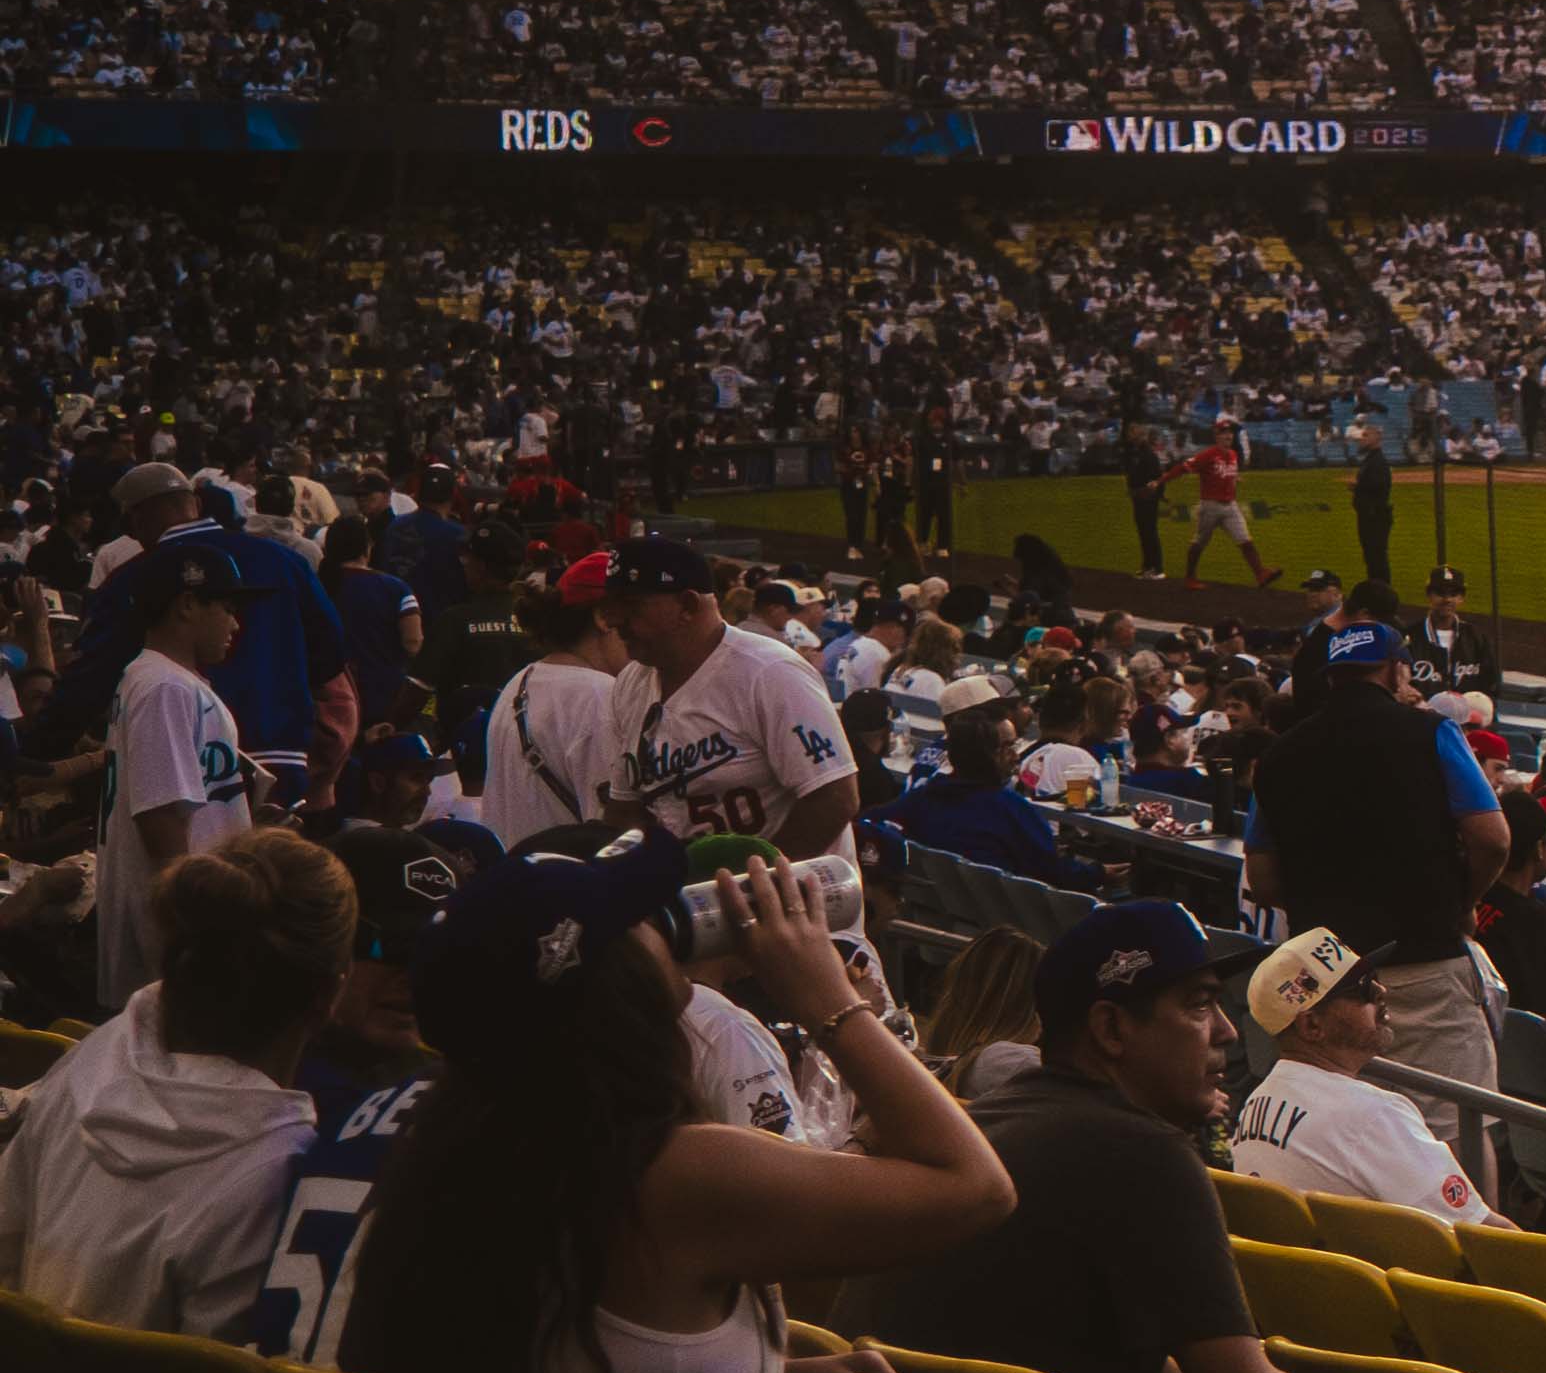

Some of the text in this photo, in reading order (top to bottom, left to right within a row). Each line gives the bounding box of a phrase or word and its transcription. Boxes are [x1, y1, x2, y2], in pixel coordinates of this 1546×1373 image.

[501, 109, 592, 153] REDS
[1353, 127, 1428, 145] 2025
[468, 621, 506, 634] GUEST
[792, 724, 836, 764] LA
[687, 786, 767, 835] 50
[411, 870, 452, 888] RVCA
